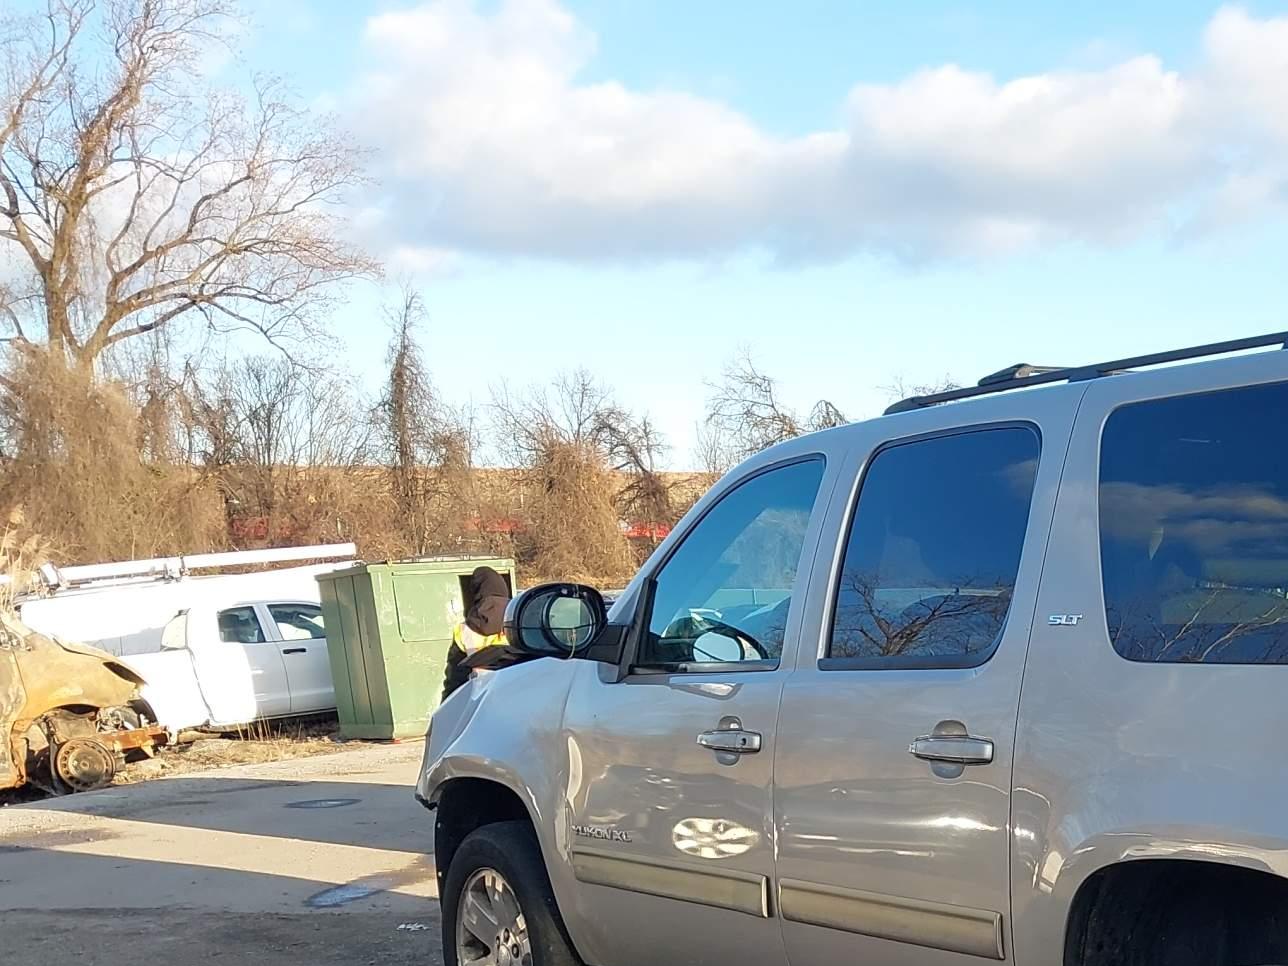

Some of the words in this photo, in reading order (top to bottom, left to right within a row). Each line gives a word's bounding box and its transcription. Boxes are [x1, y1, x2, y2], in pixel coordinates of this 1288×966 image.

[1048, 614, 1083, 626] SLT
[571, 824, 613, 841] YUKON
[612, 829, 633, 843] XL
